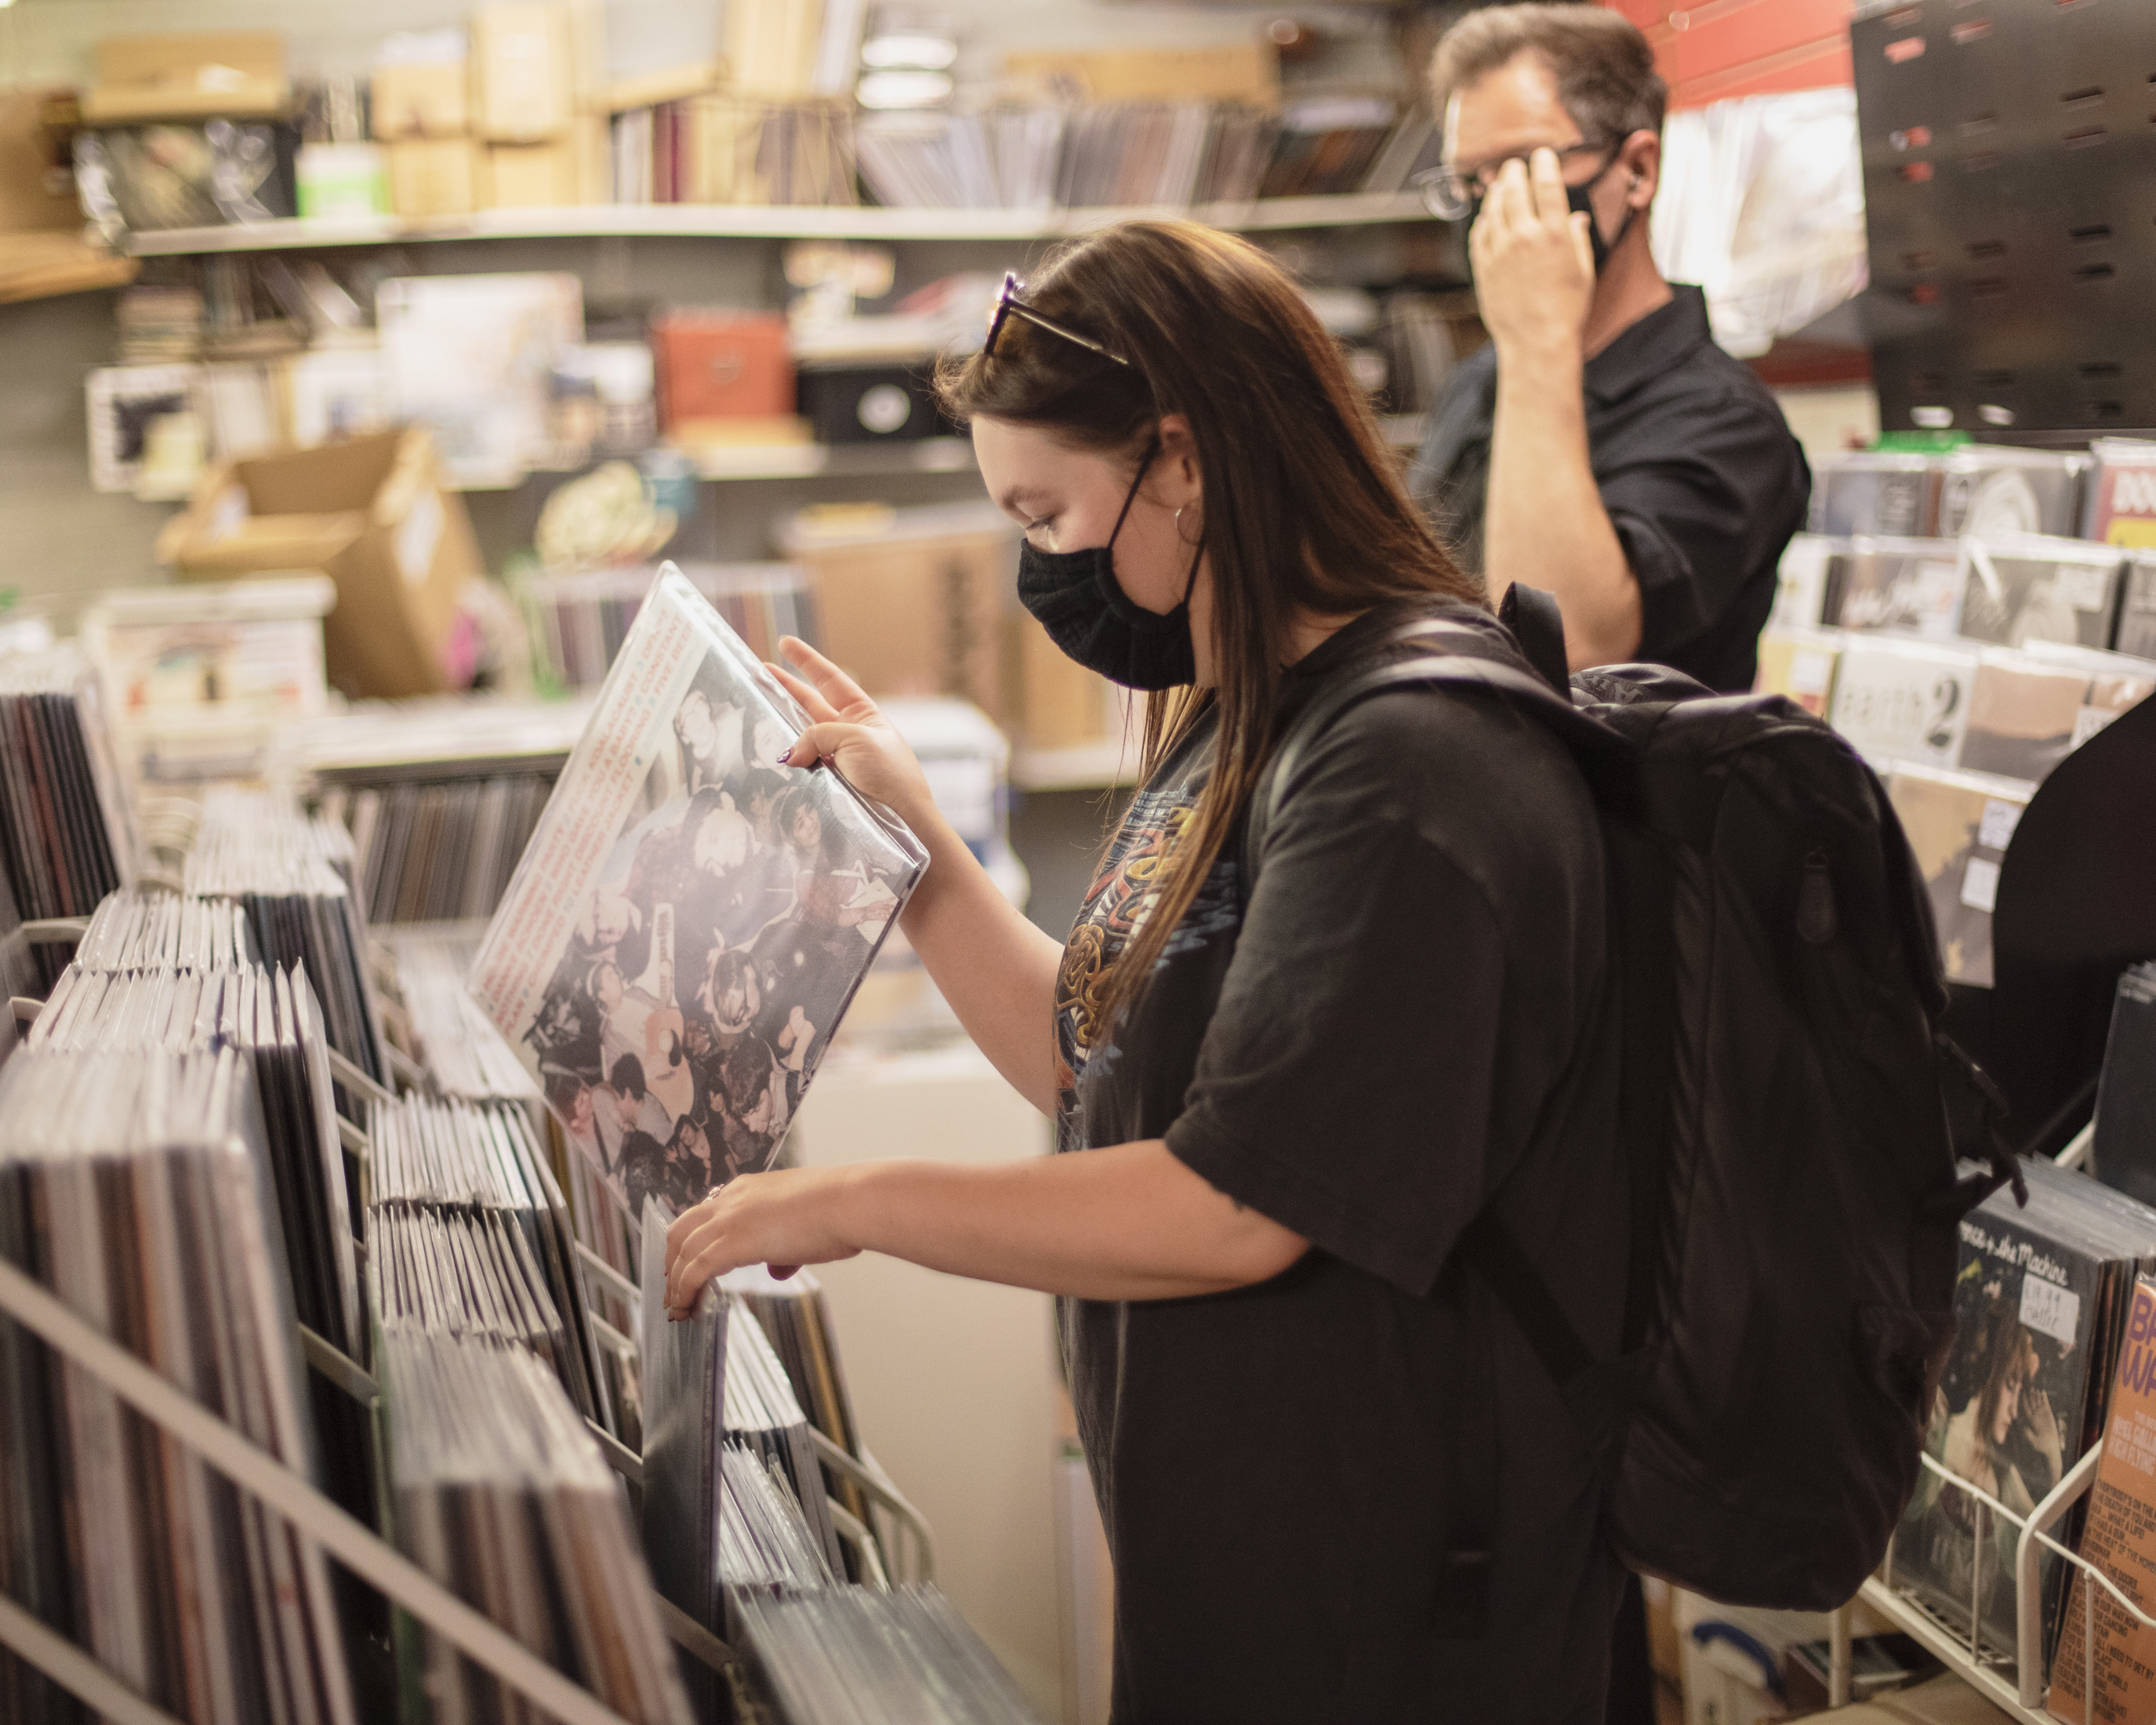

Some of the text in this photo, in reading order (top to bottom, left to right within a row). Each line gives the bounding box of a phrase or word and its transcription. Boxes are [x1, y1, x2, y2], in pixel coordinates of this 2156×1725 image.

[550, 843, 571, 880] WHO
[567, 806, 590, 844] GAVE
[588, 769, 607, 801] YOU
[602, 757, 612, 770] A
[608, 705, 638, 757] BABY?
[639, 612, 682, 694] CONSTANT
[539, 824, 564, 871] PARTY
[634, 659, 644, 672] 3
[495, 961, 528, 1025] NOTHING
[529, 907, 555, 950] DONE
[551, 862, 576, 907] RIGHT
[573, 786, 613, 860] DISCOUNT
[610, 707, 652, 784] FLOORING
[653, 661, 674, 696] FIVE
[563, 895, 575, 913] 10
[570, 830, 607, 897] LEATHER
[602, 770, 635, 832] JACKET
[2017, 1242, 2068, 1287] Machine
[2111, 1415, 2132, 1441] NOEL
[2107, 1435, 2155, 1476] HIGH FLYING
[2104, 1494, 2123, 1513] DEATH
[2123, 1505, 2131, 1516] OF
[2132, 1512, 2143, 1525] YOU
[2143, 1517, 2156, 1532] AND
[2108, 1513, 2125, 1527] WHAT
[2133, 1498, 2141, 1510] ON
[2143, 1503, 2154, 1517] THE
[2091, 1528, 2103, 1542] THE
[2103, 1534, 2118, 1551] HEAT
[2118, 1543, 2126, 1555] OF
[2127, 1547, 2138, 1563] THE
[2118, 1570, 2138, 1589] DOORS
[2100, 1599, 2112, 1612] OUR
[2112, 1608, 2125, 1621] WAY
[2124, 1615, 2140, 1631] NOW
[2103, 1614, 2128, 1637] DANCING
[2094, 1649, 2112, 1668] PLACE
[2096, 1636, 2105, 1651] ALL
[2110, 1645, 2125, 1663] NEED
[2125, 1655, 2133, 1668] TO
[2133, 1661, 2145, 1675] GET
[2145, 1668, 2154, 1681] BY
[2107, 1671, 2129, 1692] WORLD
